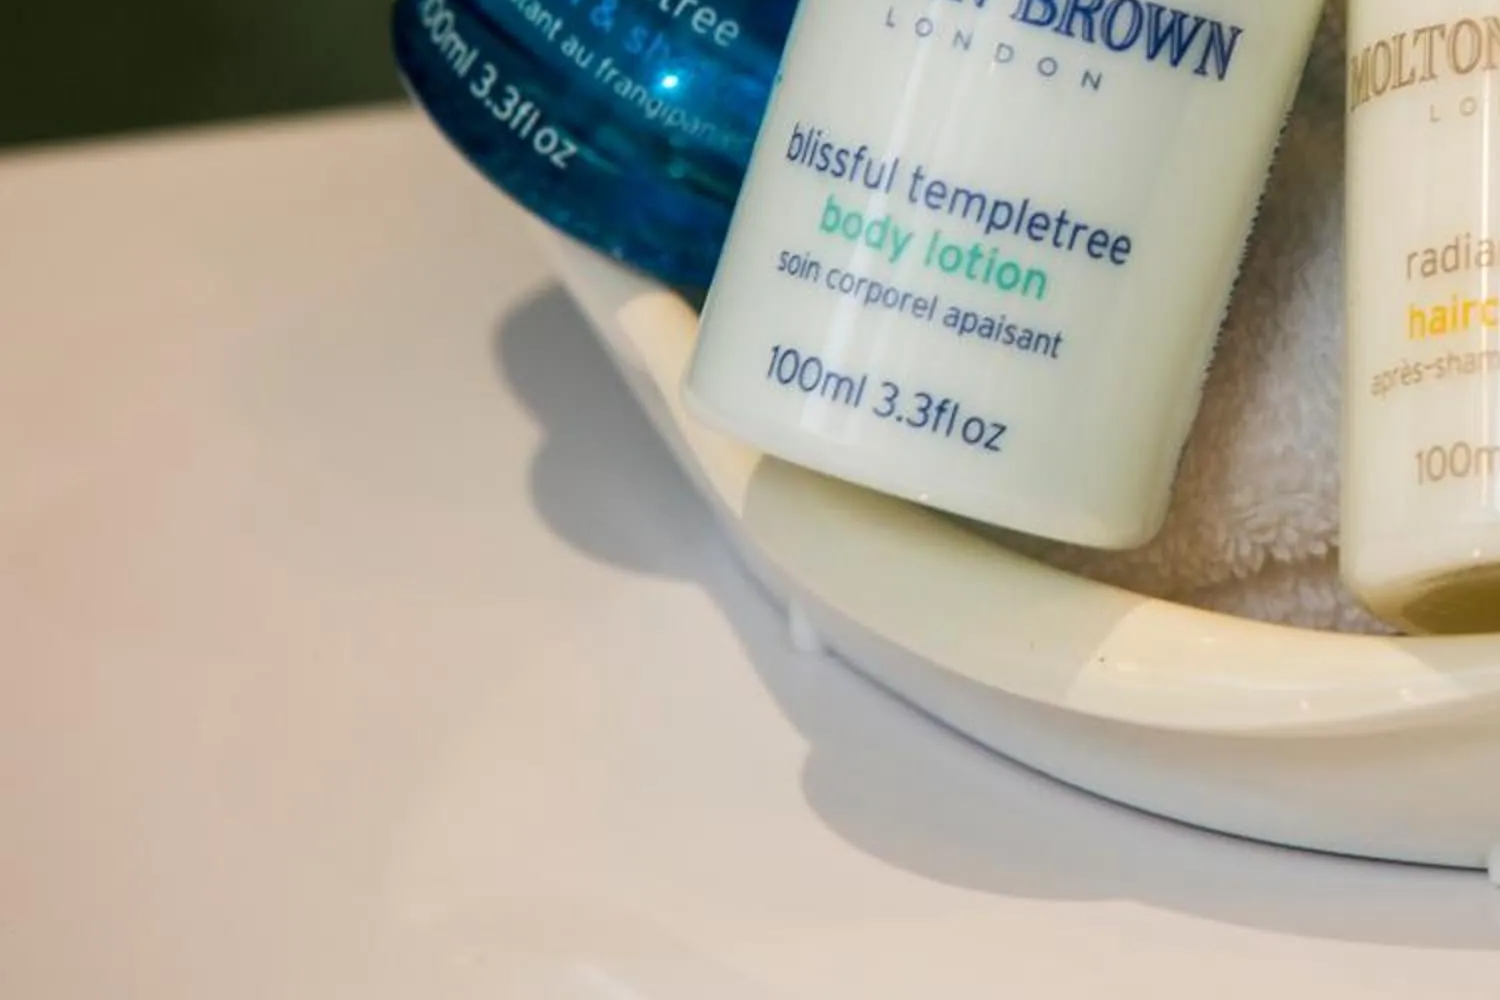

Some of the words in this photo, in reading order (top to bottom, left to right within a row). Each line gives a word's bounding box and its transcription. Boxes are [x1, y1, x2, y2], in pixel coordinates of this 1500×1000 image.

[559, 32, 597, 71] au
[885, 5, 1103, 92] LONDON
[530, 120, 582, 172] oz
[785, 122, 900, 196] blissful
[907, 165, 1134, 267] templetree
[817, 193, 914, 264] body
[924, 229, 1050, 303] lotion
[776, 247, 821, 285] soin
[825, 266, 938, 323] corporel
[942, 303, 1065, 361] apaisant
[765, 342, 867, 410] 100ml
[872, 379, 960, 440] 3.3fl
[960, 413, 1009, 455] oz
